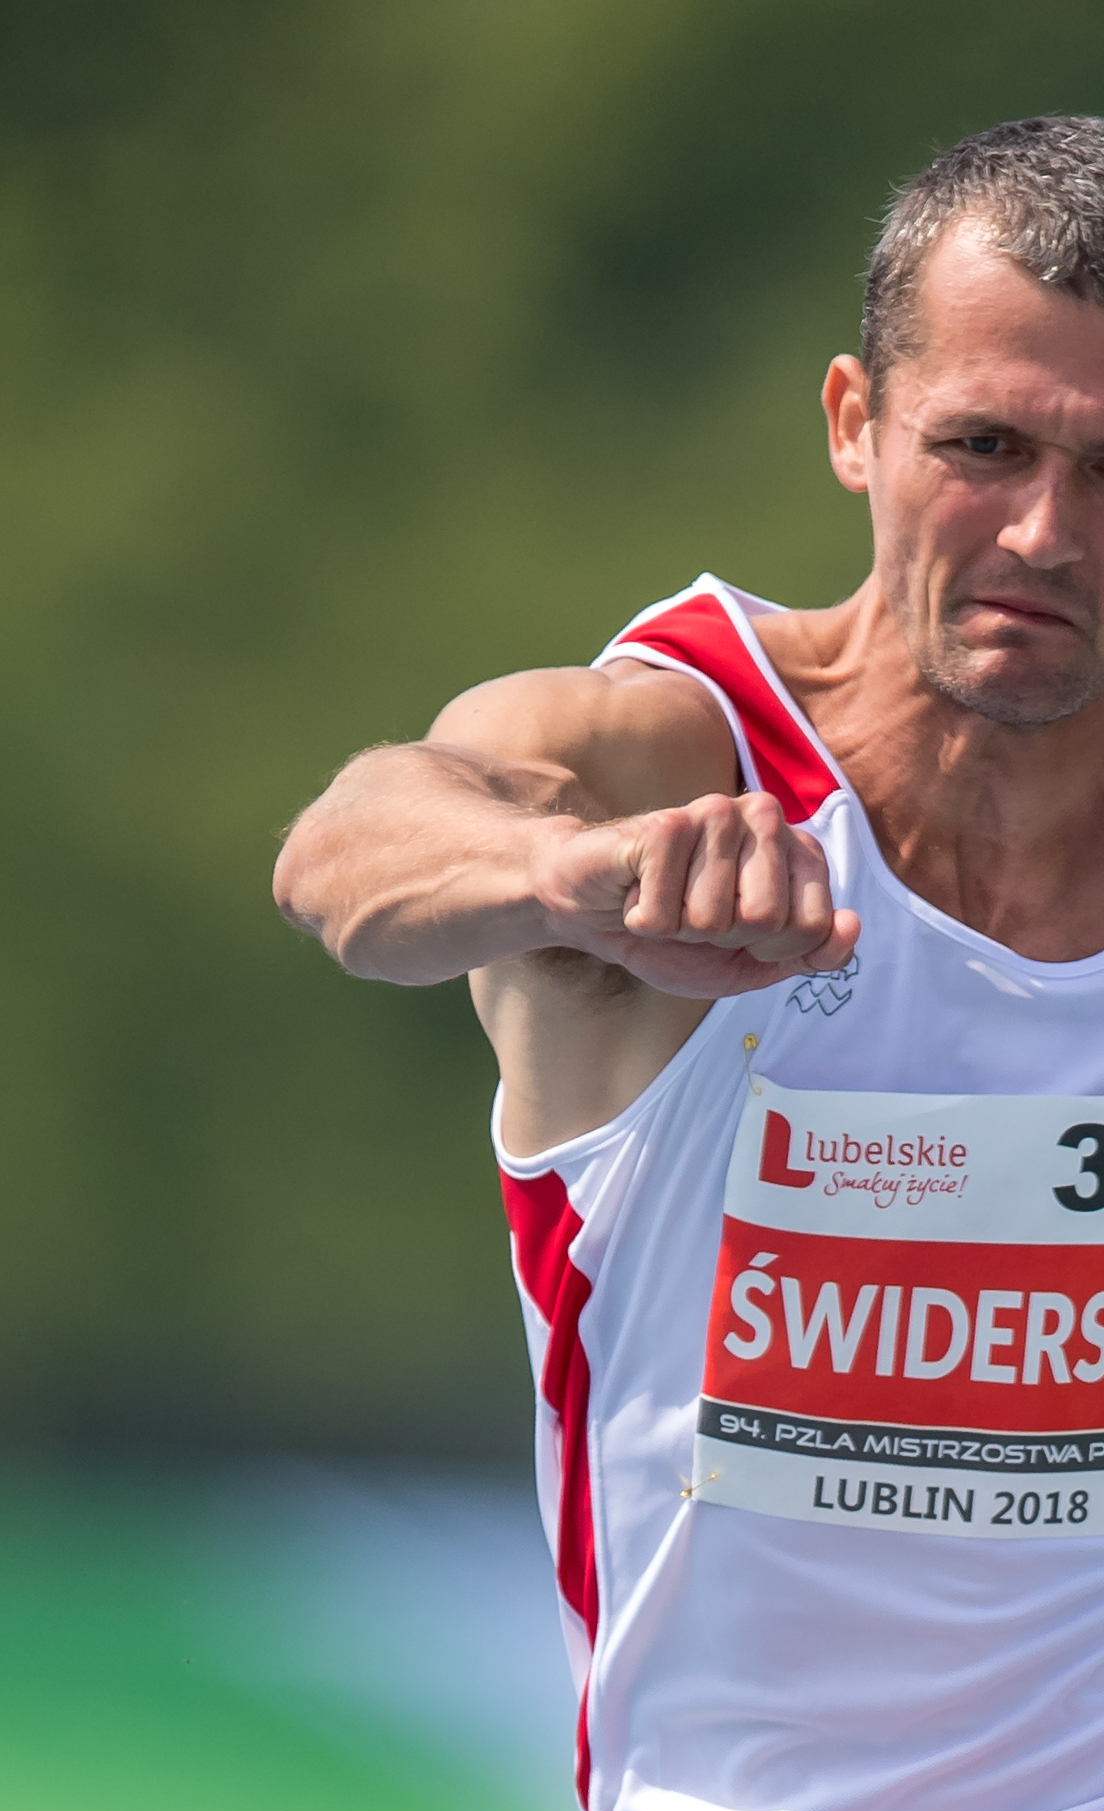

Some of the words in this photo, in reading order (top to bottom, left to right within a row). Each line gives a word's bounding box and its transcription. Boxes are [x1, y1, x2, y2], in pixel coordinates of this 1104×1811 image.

[806, 1131, 967, 1167] lubelskie
[823, 1171, 905, 1209] Smakuj
[906, 1174, 969, 1205] życie!
[719, 1413, 766, 1441] 94.
[775, 1423, 856, 1452] PZLA
[863, 1434, 1083, 1464] MISTRZOSTWA
[812, 1475, 975, 1523] LUBLIN
[991, 1490, 1090, 1525] 2018
